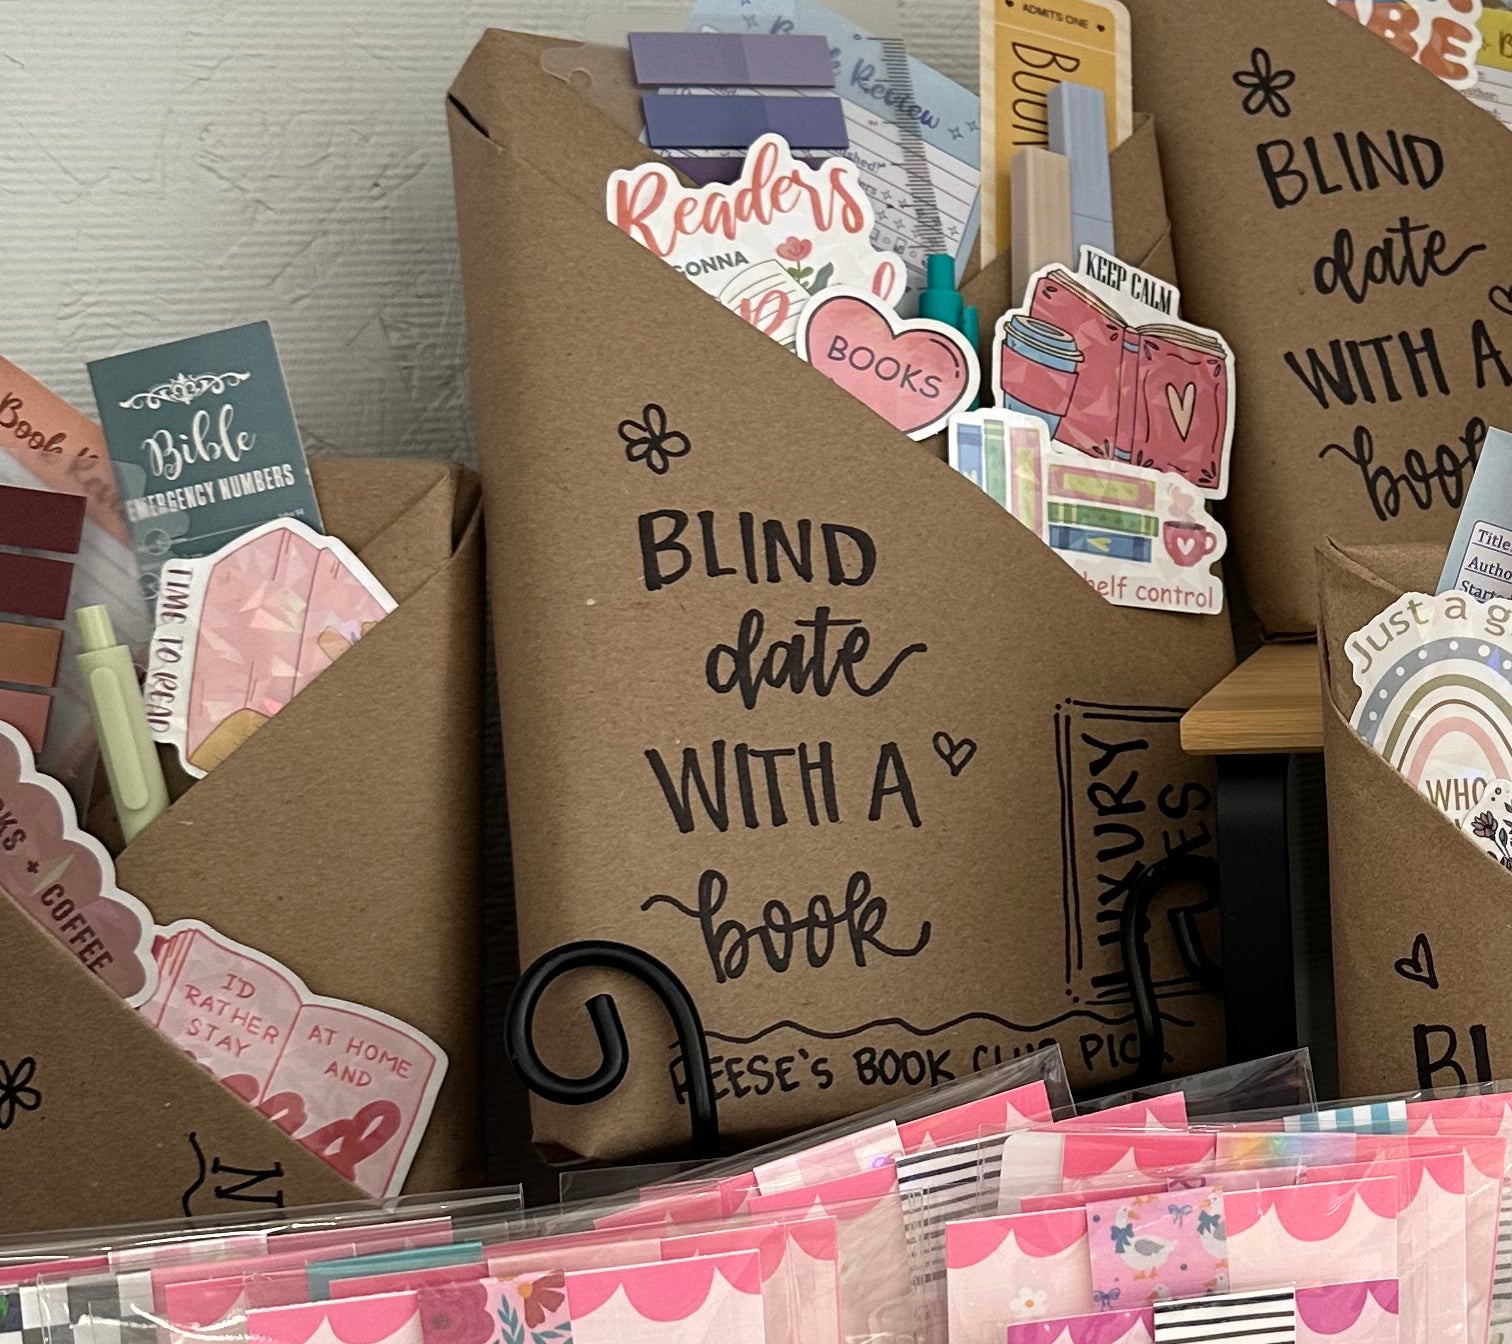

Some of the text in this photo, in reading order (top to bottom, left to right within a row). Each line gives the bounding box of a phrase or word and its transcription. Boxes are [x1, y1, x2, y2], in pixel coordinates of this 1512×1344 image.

[1022, 3, 1088, 29] ADMITS ONE
[617, 142, 864, 257] Readers
[1257, 132, 1444, 208] BLIND
[1086, 250, 1172, 314] KEEP CALM
[1314, 216, 1487, 304] date
[827, 335, 941, 398] BOOKS
[1284, 327, 1450, 410] WITH
[0, 392, 66, 454] Book
[142, 404, 255, 480] Bible
[126, 464, 295, 521] EMERGENCY NUMBERS
[638, 509, 876, 590] BLIND
[162, 568, 193, 625] TIME
[1137, 584, 1213, 609] control
[155, 637, 183, 664] TO
[707, 607, 928, 709] date
[1352, 598, 1428, 673] Just
[1444, 596, 1467, 620] a
[644, 740, 921, 834] WITH A
[41, 883, 114, 976] COFFEE
[641, 870, 932, 983] book
[184, 984, 280, 1043] RATHER
[221, 972, 256, 998] I'D
[187, 1019, 251, 1058] STAY
[308, 1024, 413, 1079] AT HOME
[854, 1047, 955, 1087] BOOK
[325, 1062, 372, 1088] AND
